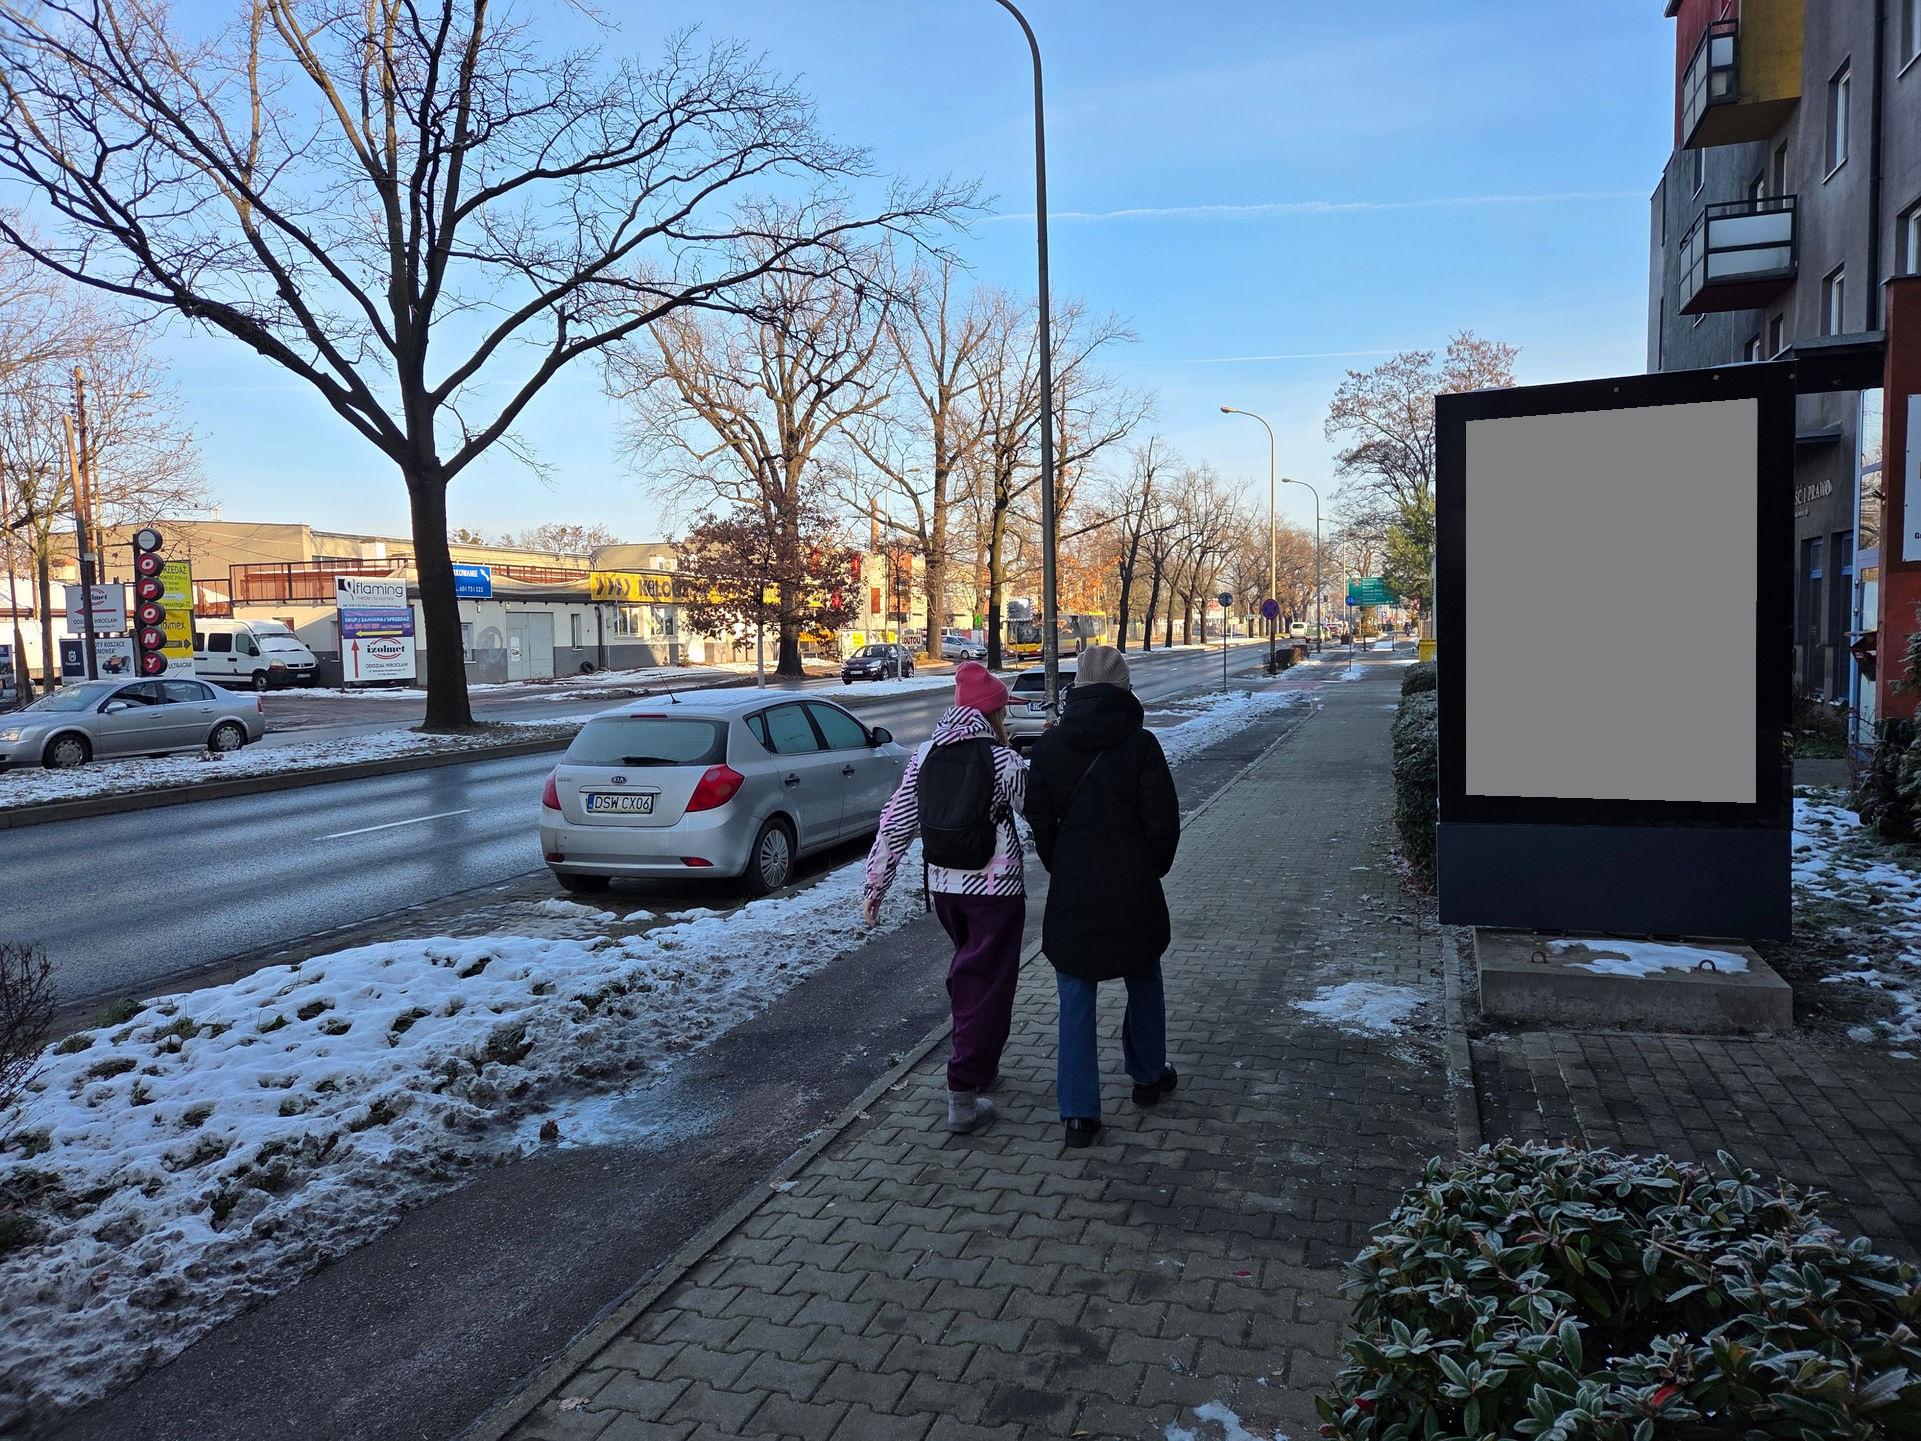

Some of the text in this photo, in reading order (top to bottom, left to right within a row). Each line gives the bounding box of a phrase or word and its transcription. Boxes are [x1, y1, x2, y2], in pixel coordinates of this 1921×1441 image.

[355, 581, 403, 598] flaming
[366, 644, 405, 654] izolmet
[594, 795, 650, 810] DSW CX06
